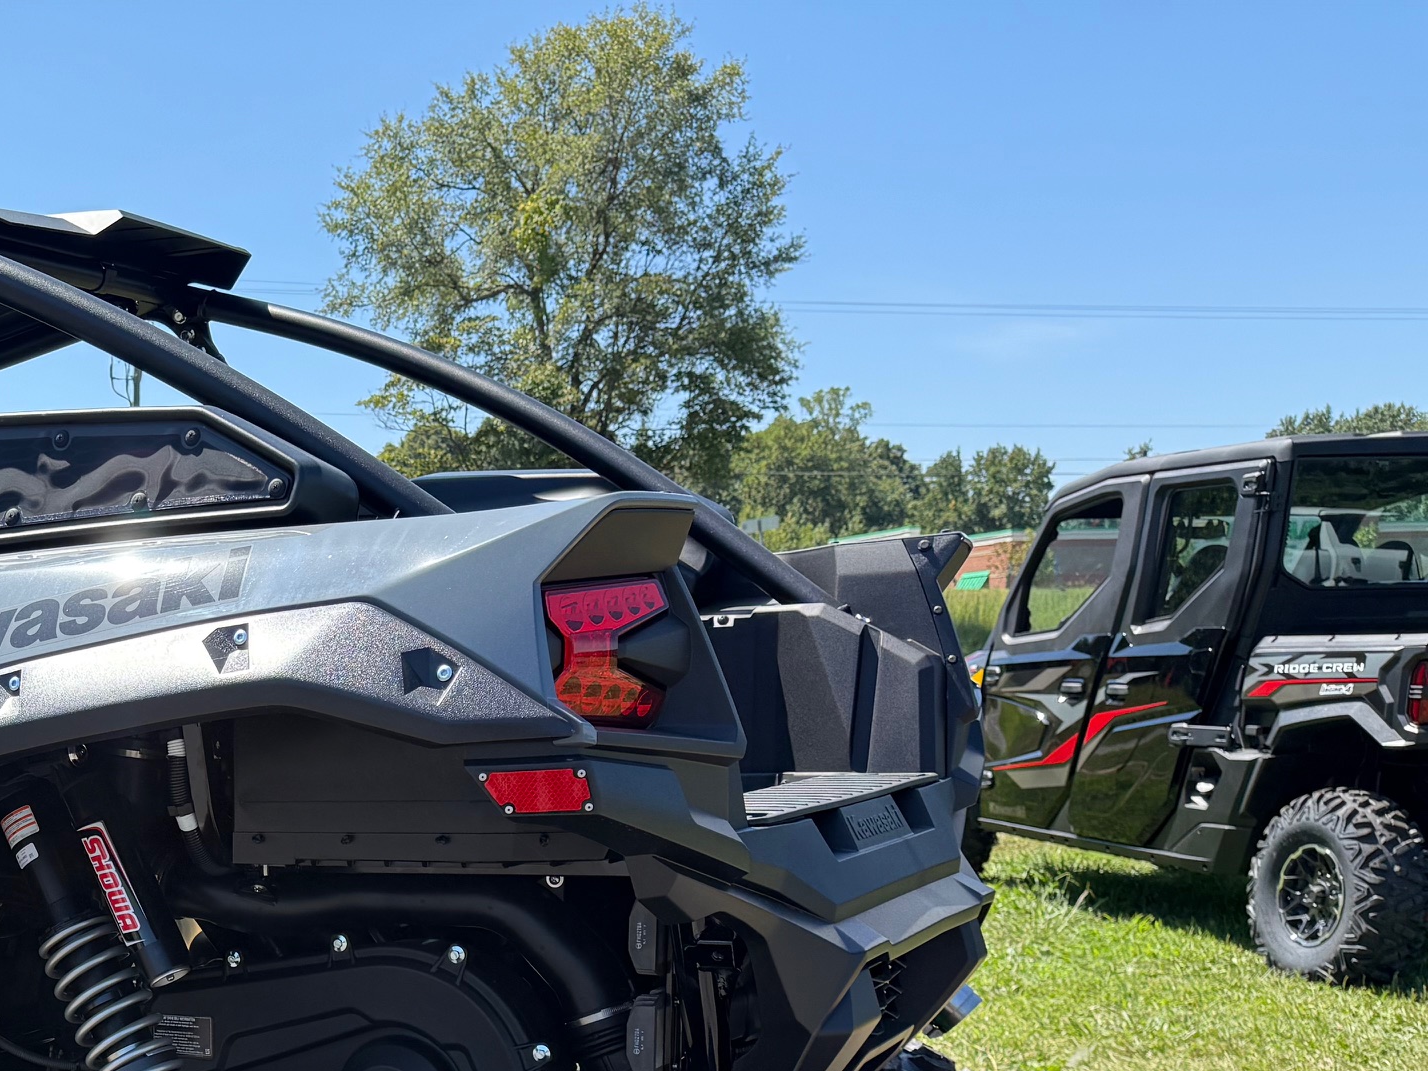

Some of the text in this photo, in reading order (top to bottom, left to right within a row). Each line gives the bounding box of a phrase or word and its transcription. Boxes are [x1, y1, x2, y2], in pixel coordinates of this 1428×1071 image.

[1274, 662, 1365, 674] RIDGE CREW
[846, 804, 904, 841] Kawasaki
[81, 835, 140, 933] SHOWA
